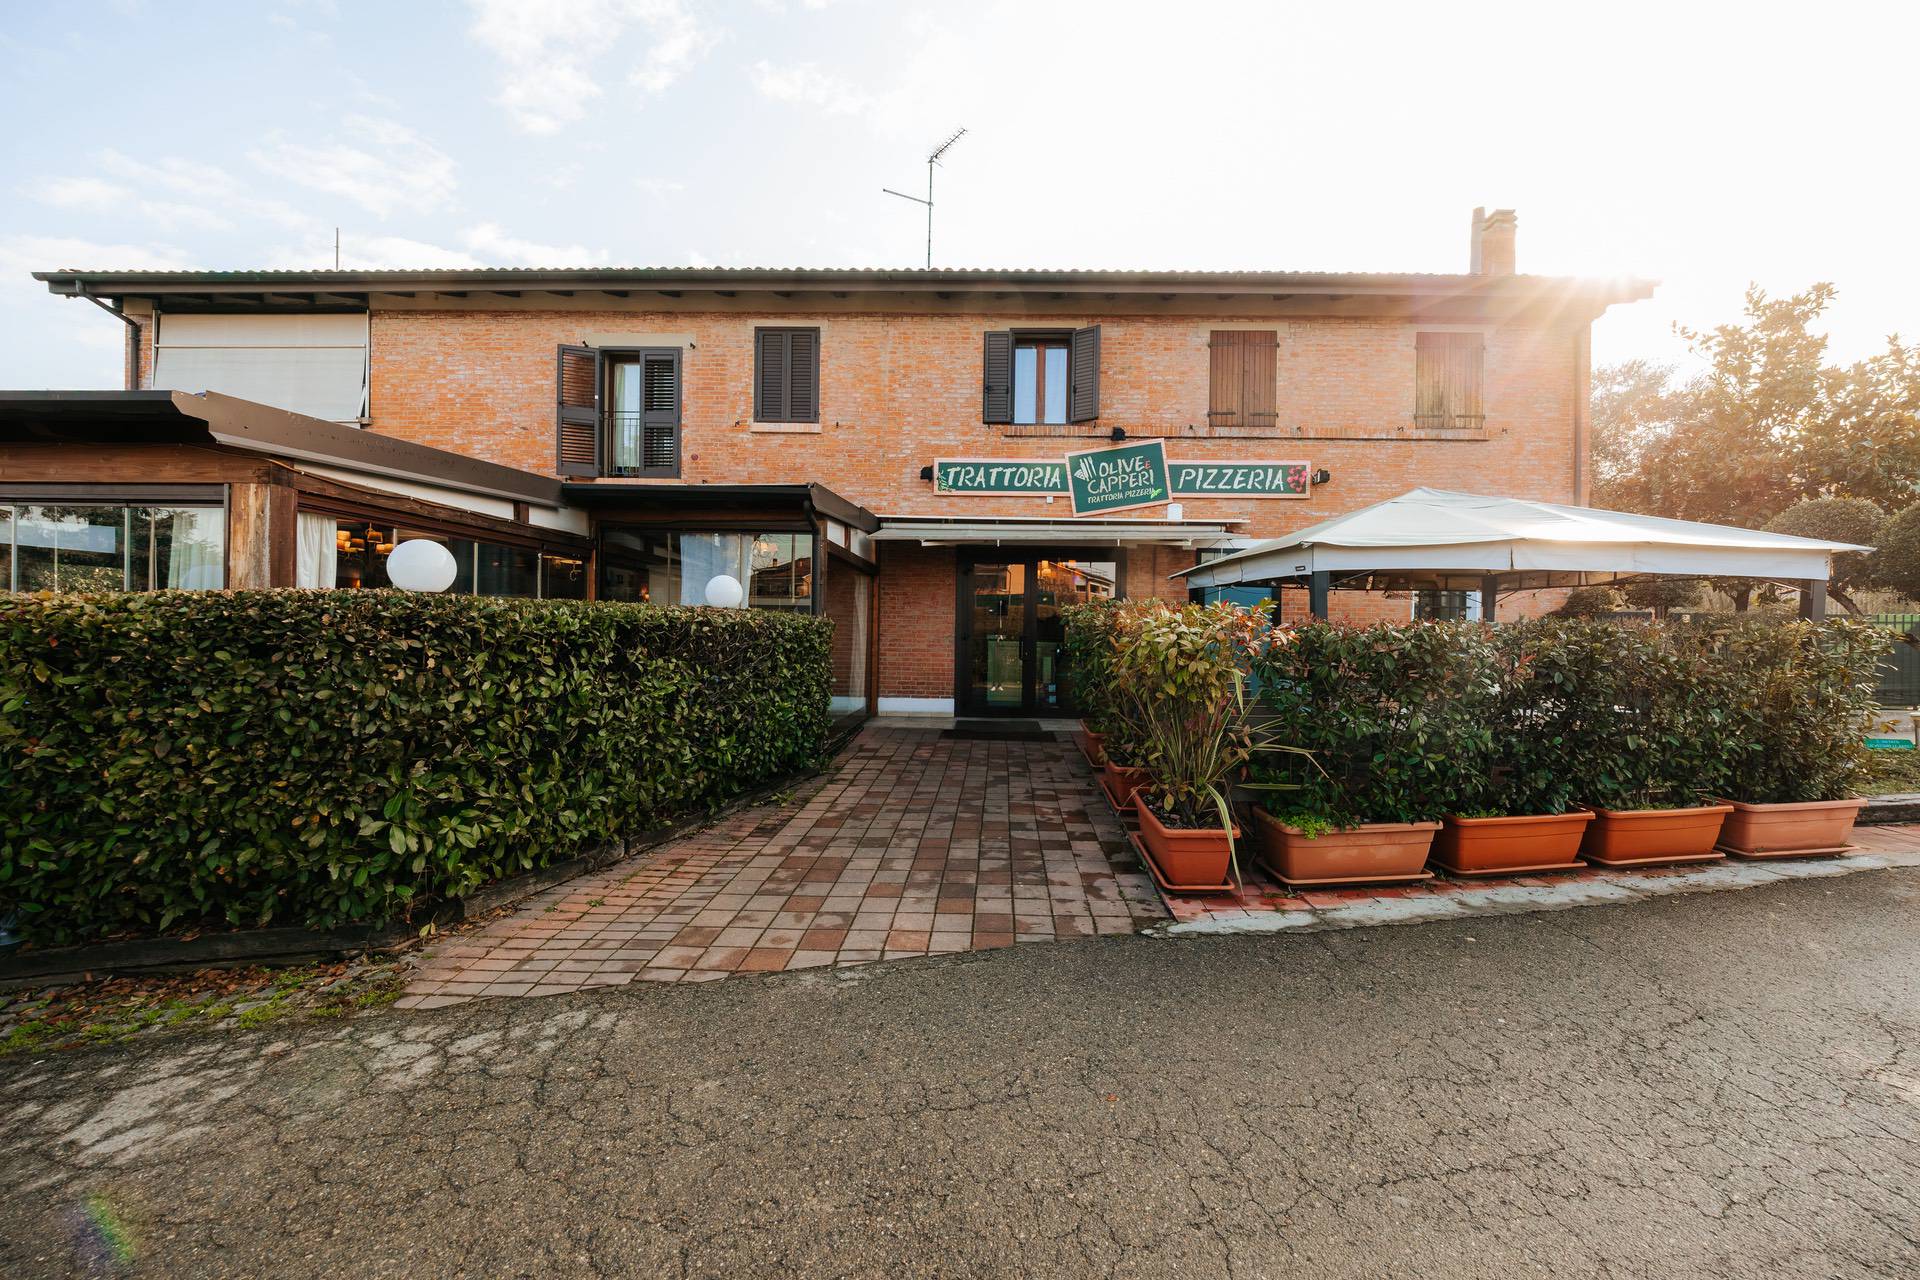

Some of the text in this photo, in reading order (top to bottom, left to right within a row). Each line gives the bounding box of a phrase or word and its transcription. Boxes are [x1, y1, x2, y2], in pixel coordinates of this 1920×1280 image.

[947, 466, 1061, 488] TRATTORIA
[1099, 456, 1151, 477] OLIVE E
[1087, 469, 1154, 494] CAPPERI
[1178, 468, 1284, 491] PIZZERIA
[1088, 492, 1124, 504] TRATTORIA
